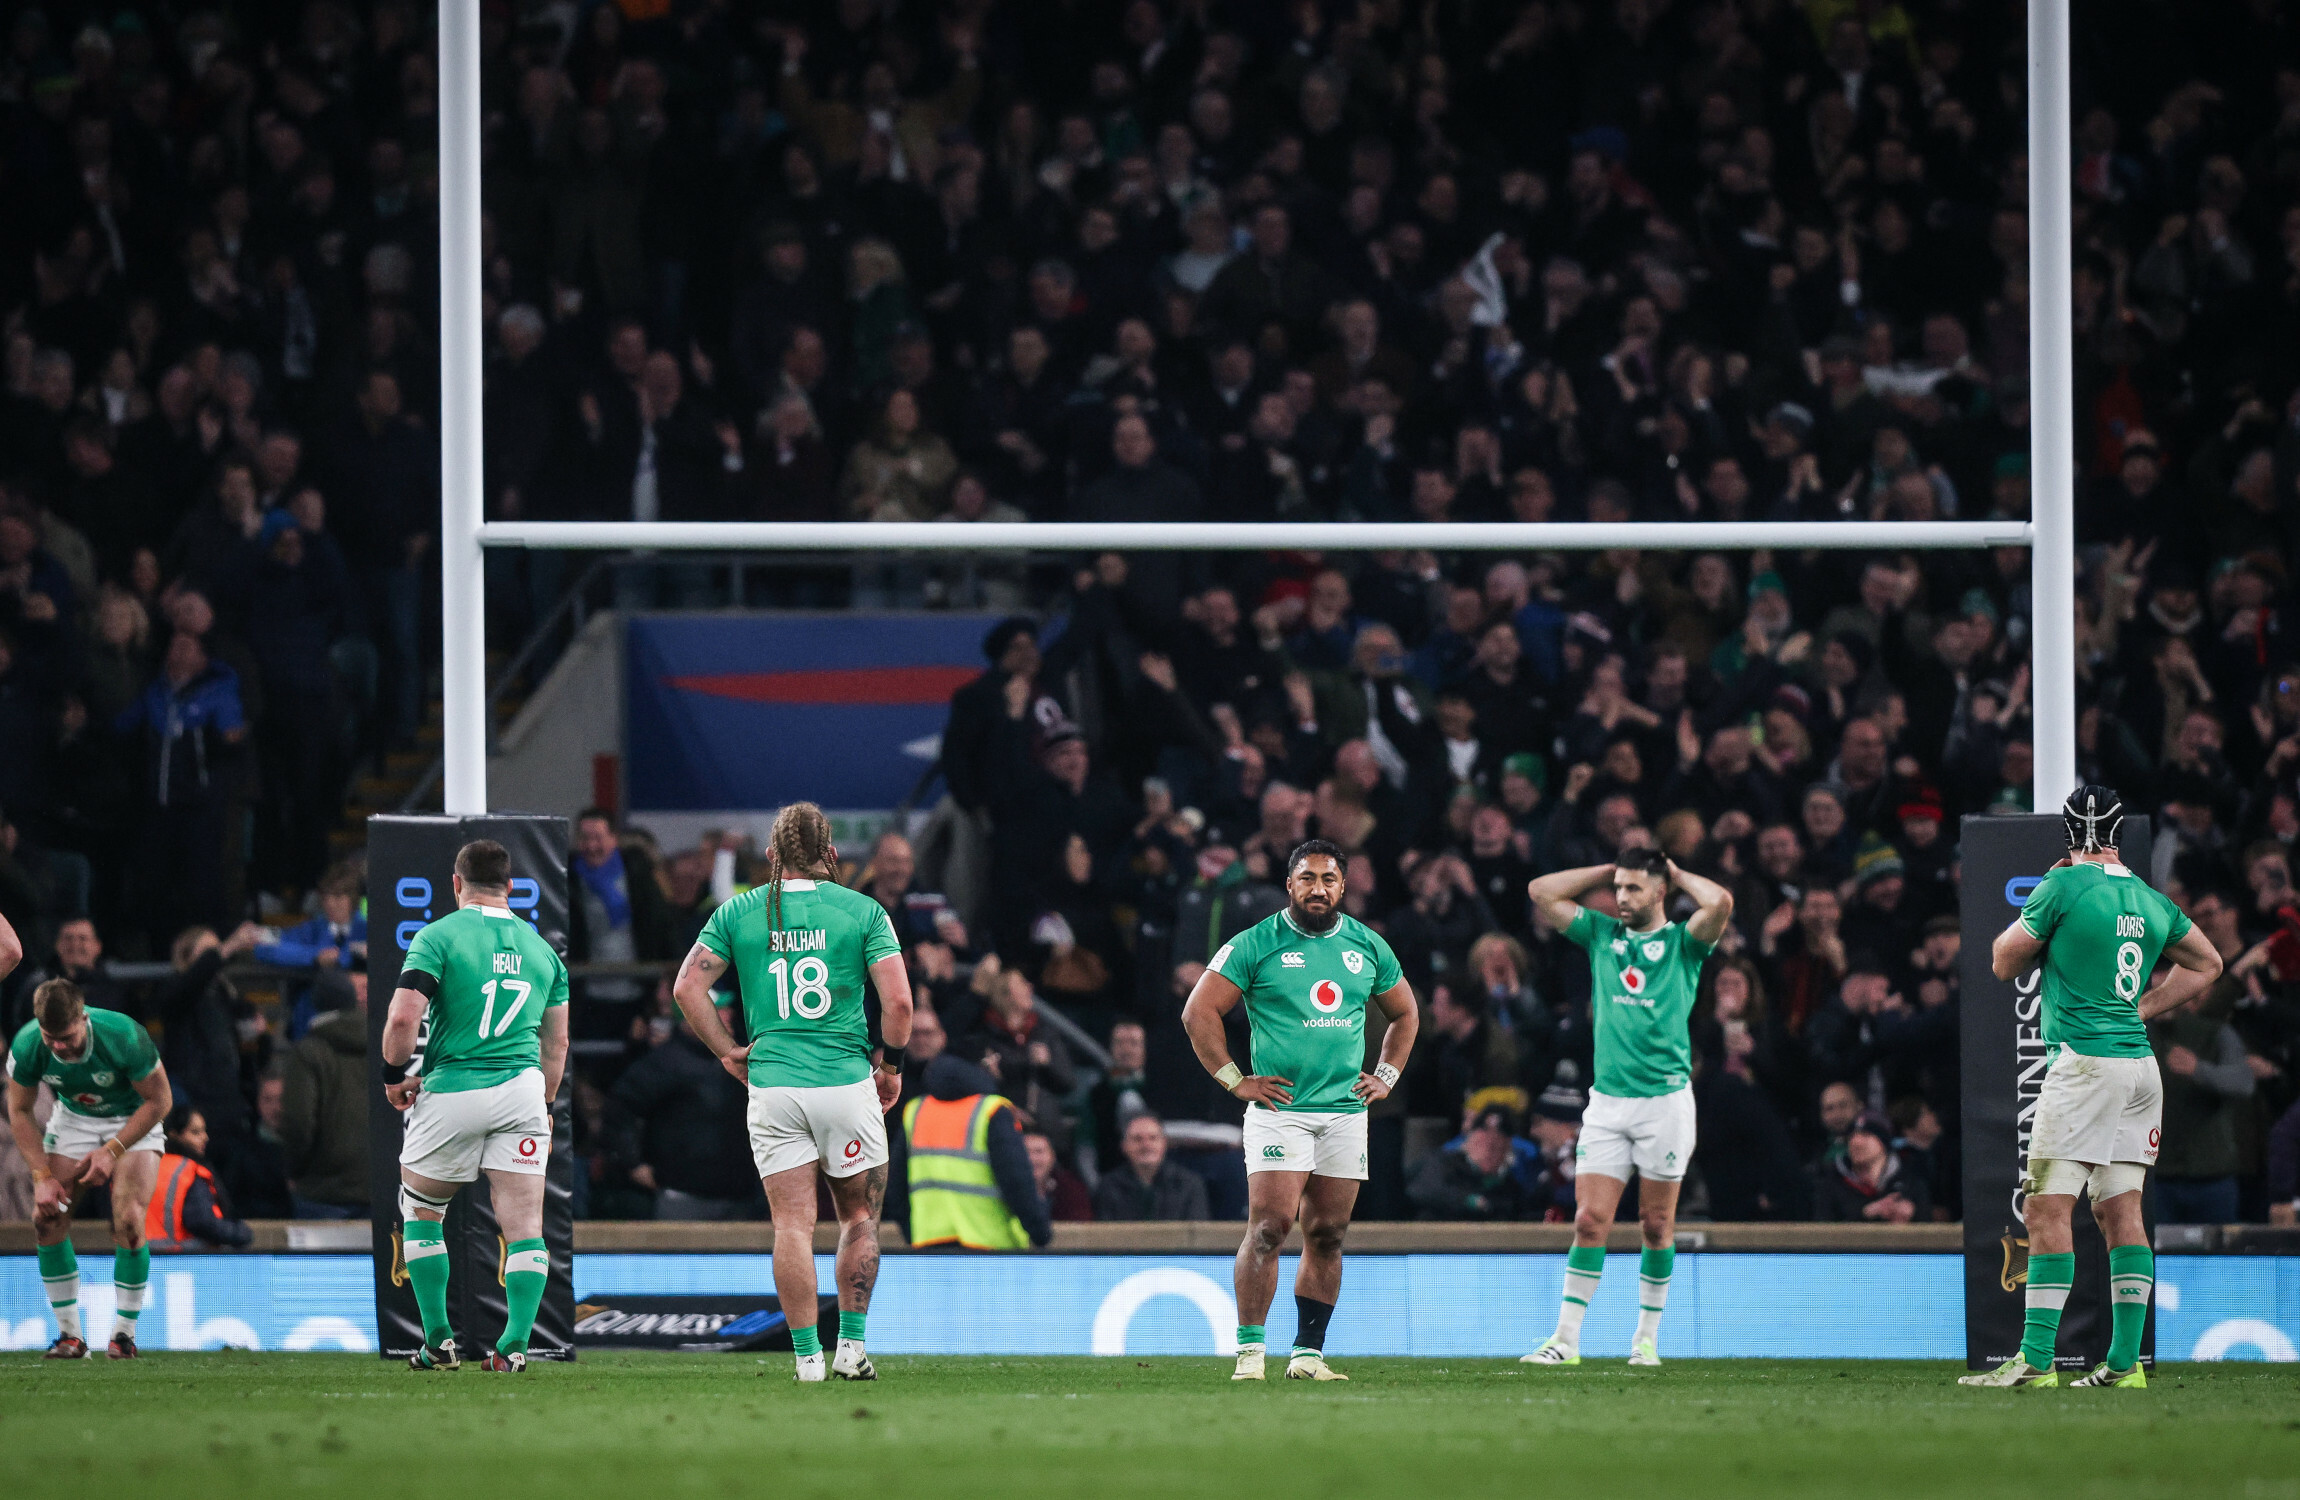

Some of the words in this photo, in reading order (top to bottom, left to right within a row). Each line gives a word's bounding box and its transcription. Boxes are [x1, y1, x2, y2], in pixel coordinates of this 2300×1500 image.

[2116, 914, 2145, 938] DORIS
[769, 929, 826, 952] BEALHAM
[493, 953, 523, 975] HEALY
[2115, 941, 2143, 1002] 8
[768, 956, 832, 1020] 18
[478, 979, 532, 1039] 17
[1302, 1016, 1352, 1028] vodafone
[512, 1157, 540, 1165] vodafone
